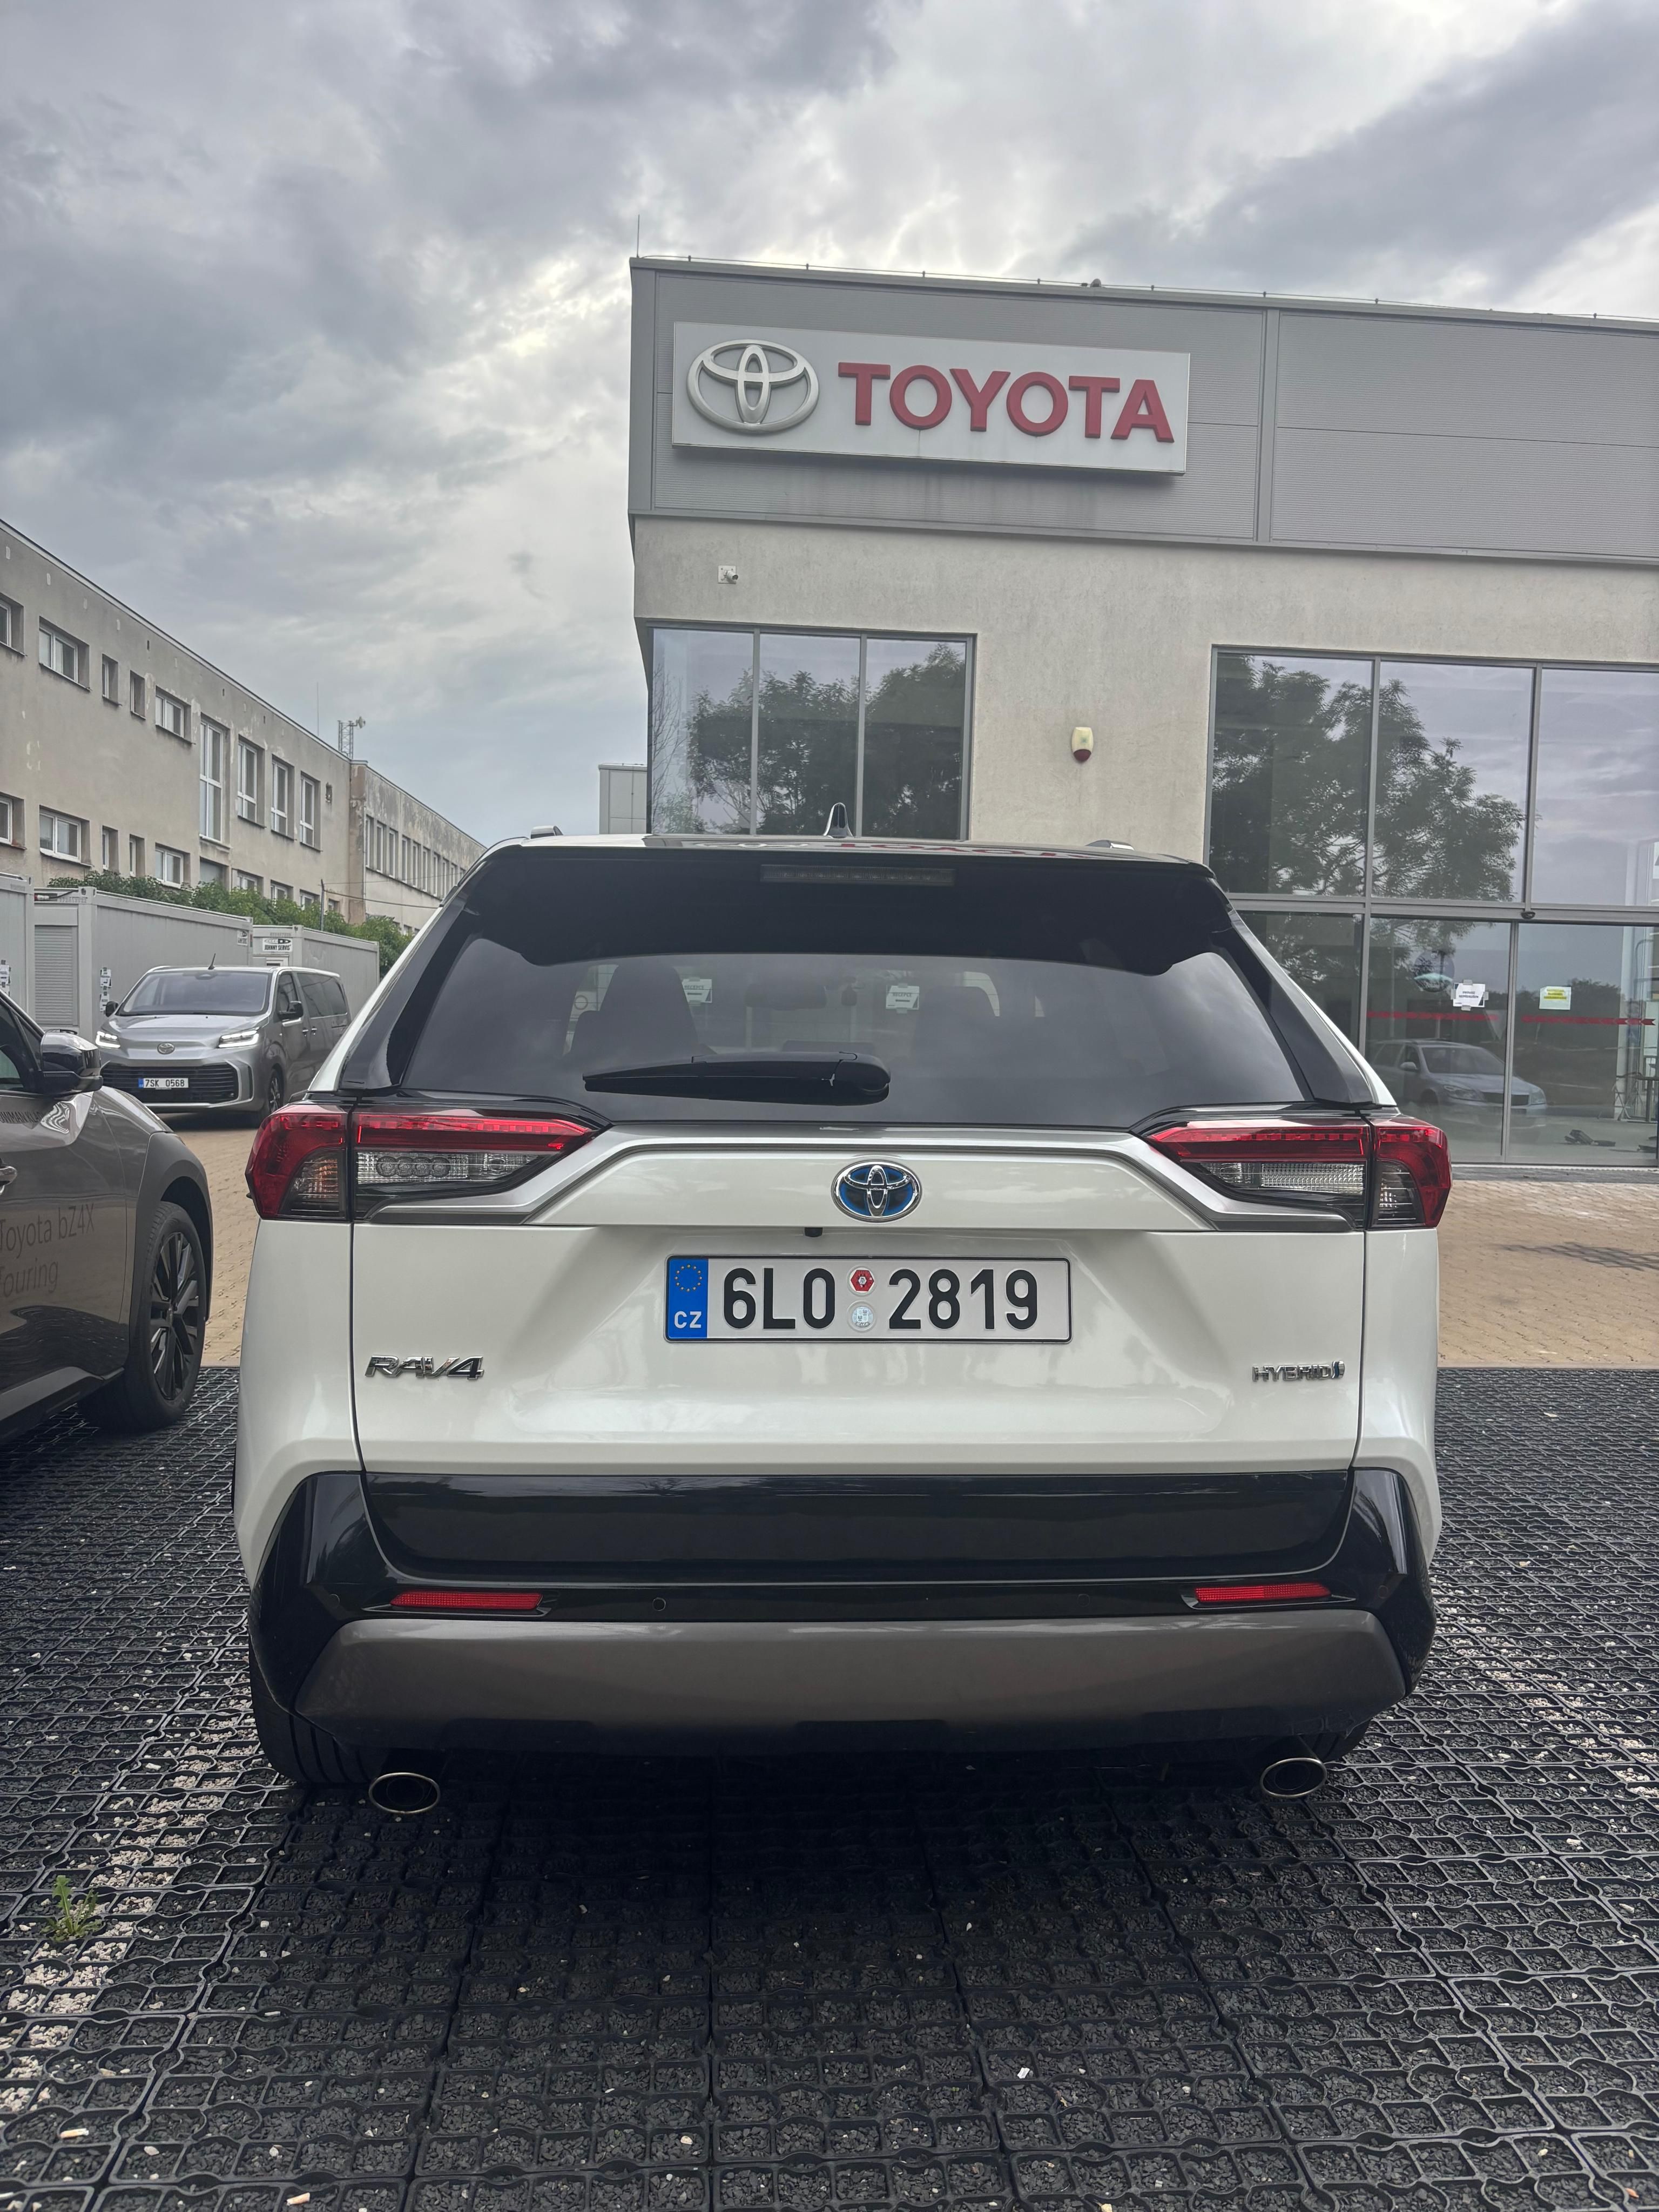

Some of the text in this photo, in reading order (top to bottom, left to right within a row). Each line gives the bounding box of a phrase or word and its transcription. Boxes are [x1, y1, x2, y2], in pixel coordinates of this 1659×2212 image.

[838, 362, 1175, 443] TOYOTA
[0, 1203, 95, 1259] Toyota bZ4X
[723, 1267, 1037, 1330] 6L0 2819
[674, 1311, 702, 1328] CZ
[365, 1355, 485, 1380] RAV4
[1252, 1364, 1332, 1382] HYBRID
